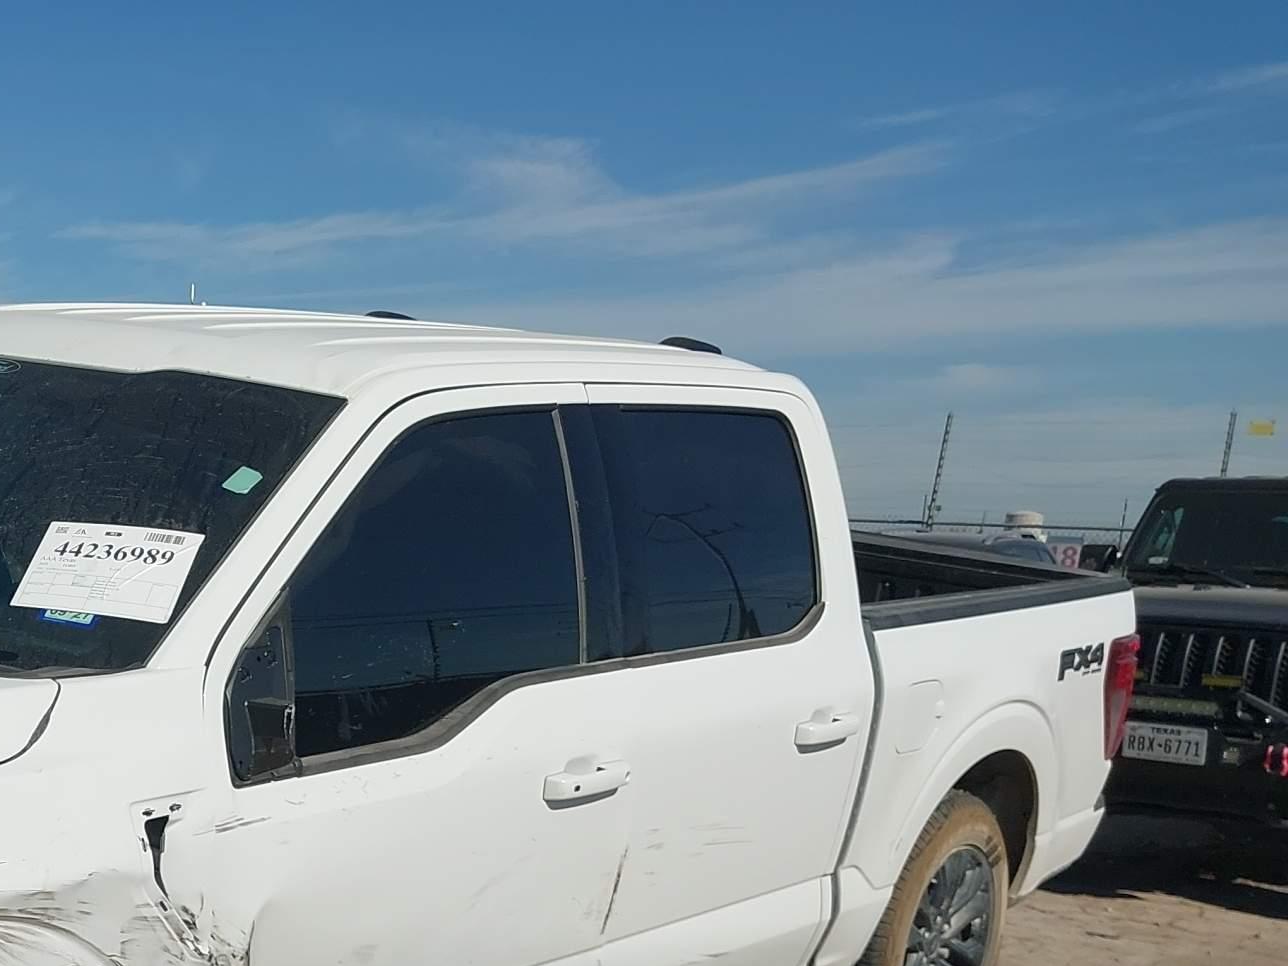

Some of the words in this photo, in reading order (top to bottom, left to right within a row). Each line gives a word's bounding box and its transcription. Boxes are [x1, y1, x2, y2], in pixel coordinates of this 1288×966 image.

[54, 541, 175, 566] 44236989
[1056, 642, 1104, 682] FX4
[1151, 726, 1181, 737] TEXAS
